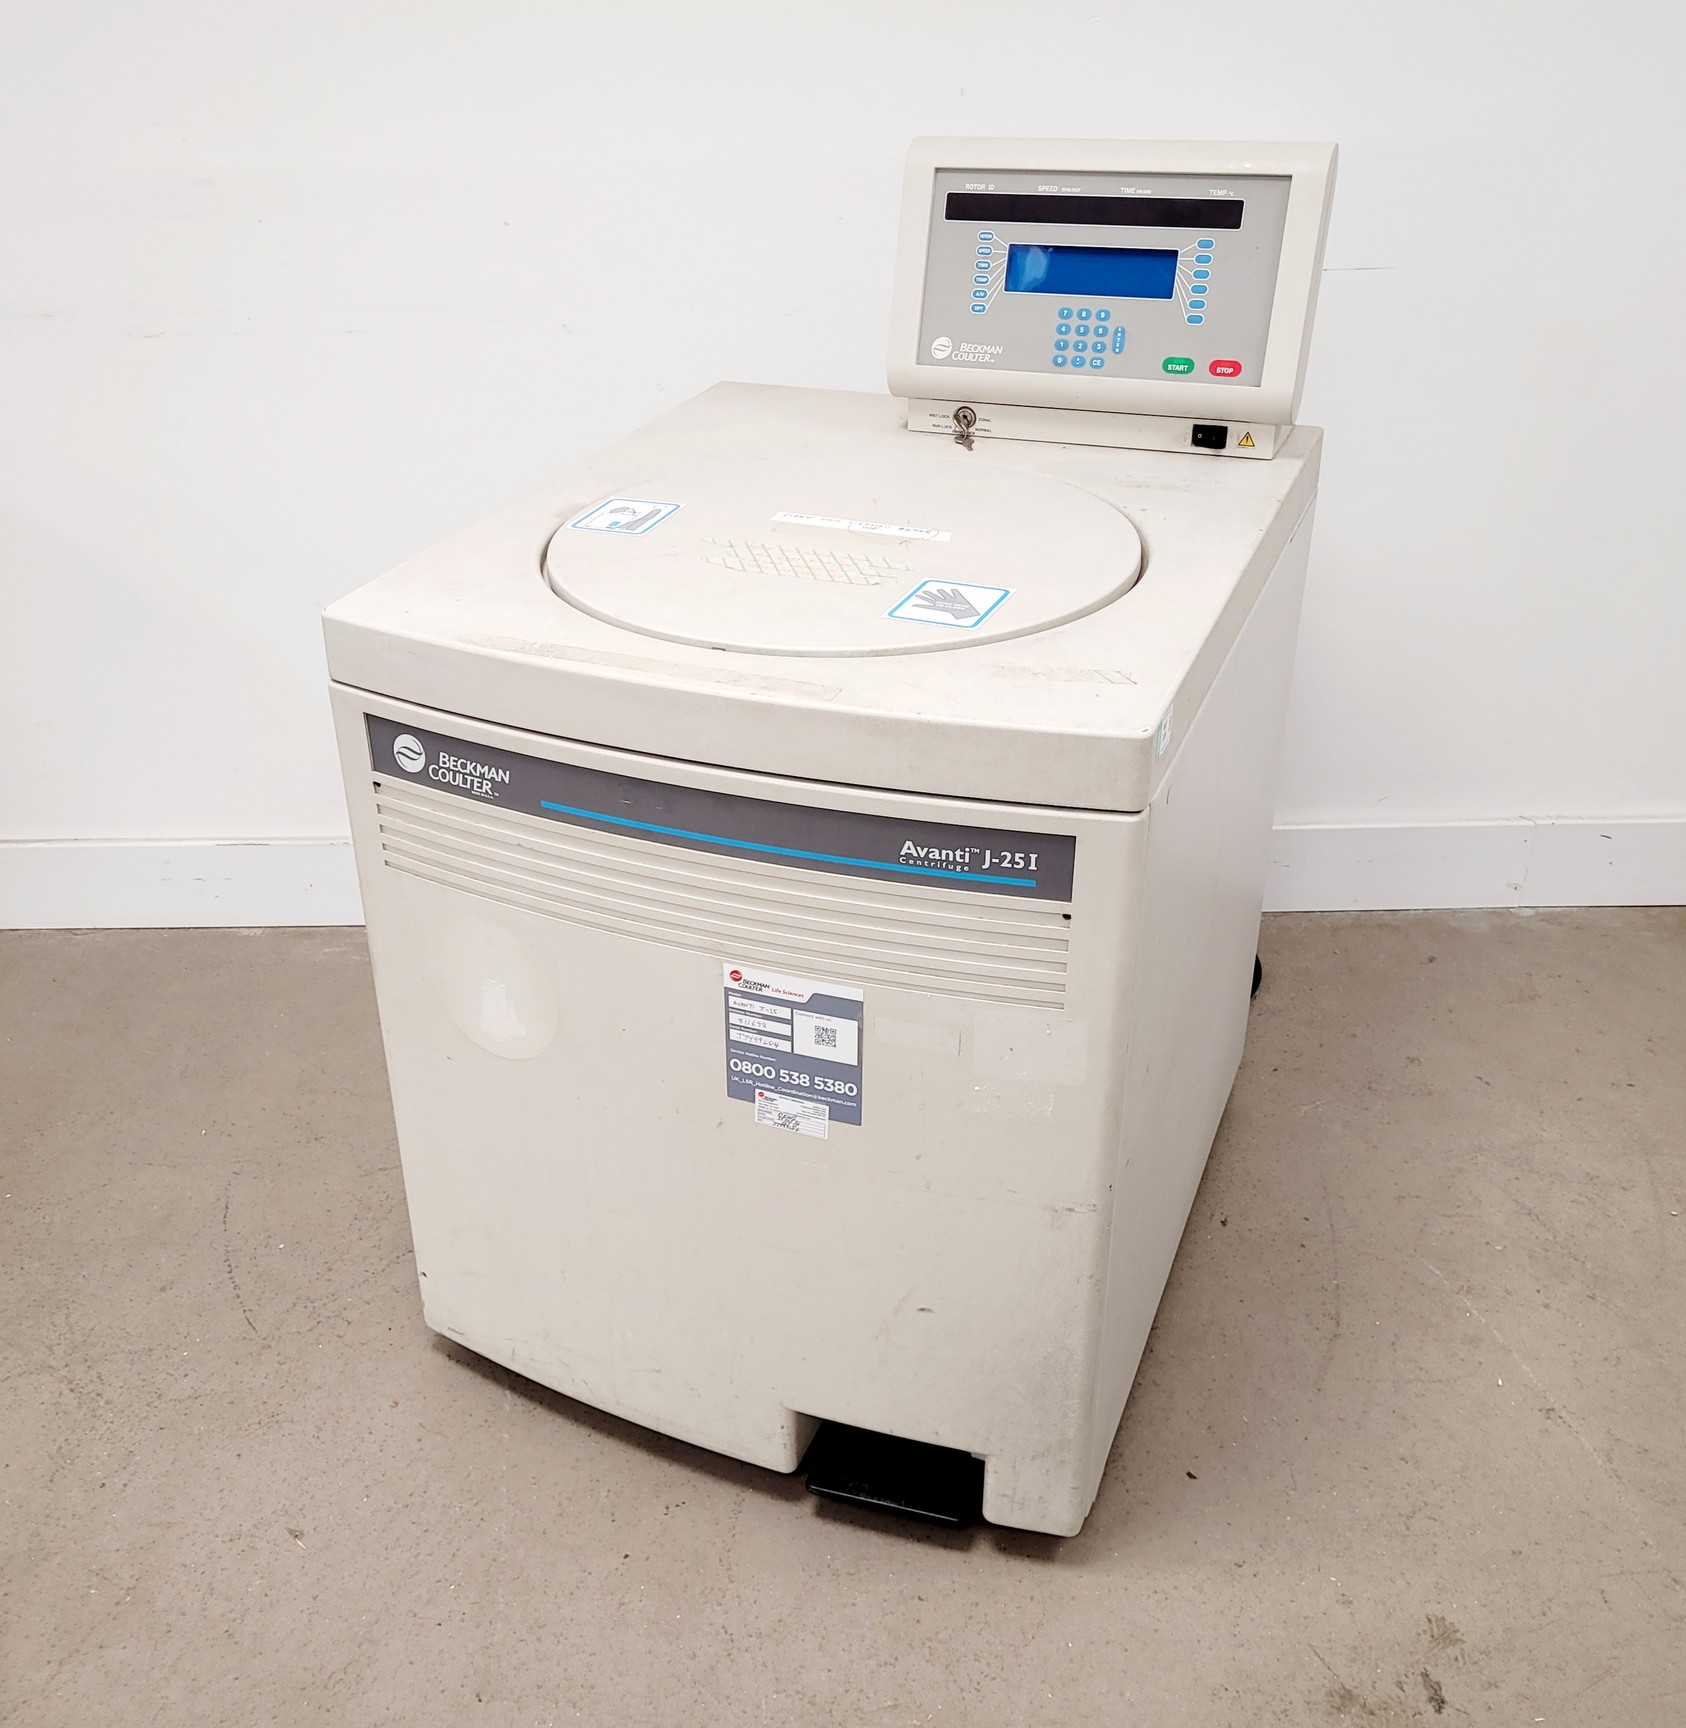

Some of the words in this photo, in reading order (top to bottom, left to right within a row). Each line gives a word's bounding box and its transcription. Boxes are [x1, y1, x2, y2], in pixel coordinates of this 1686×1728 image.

[1209, 189, 1228, 197] TEMP
[960, 342, 1003, 354] BECKMAN
[1167, 364, 1189, 372] START
[439, 751, 510, 784] BECKMAN
[899, 856, 970, 872] Centrifuge
[738, 982, 763, 992] COULTER
[742, 979, 770, 989] BECKMAN
[782, 988, 804, 998] Sciences
[729, 1058, 776, 1080] 0800
[779, 1068, 811, 1088] 538
[813, 1076, 858, 1097] 5380
